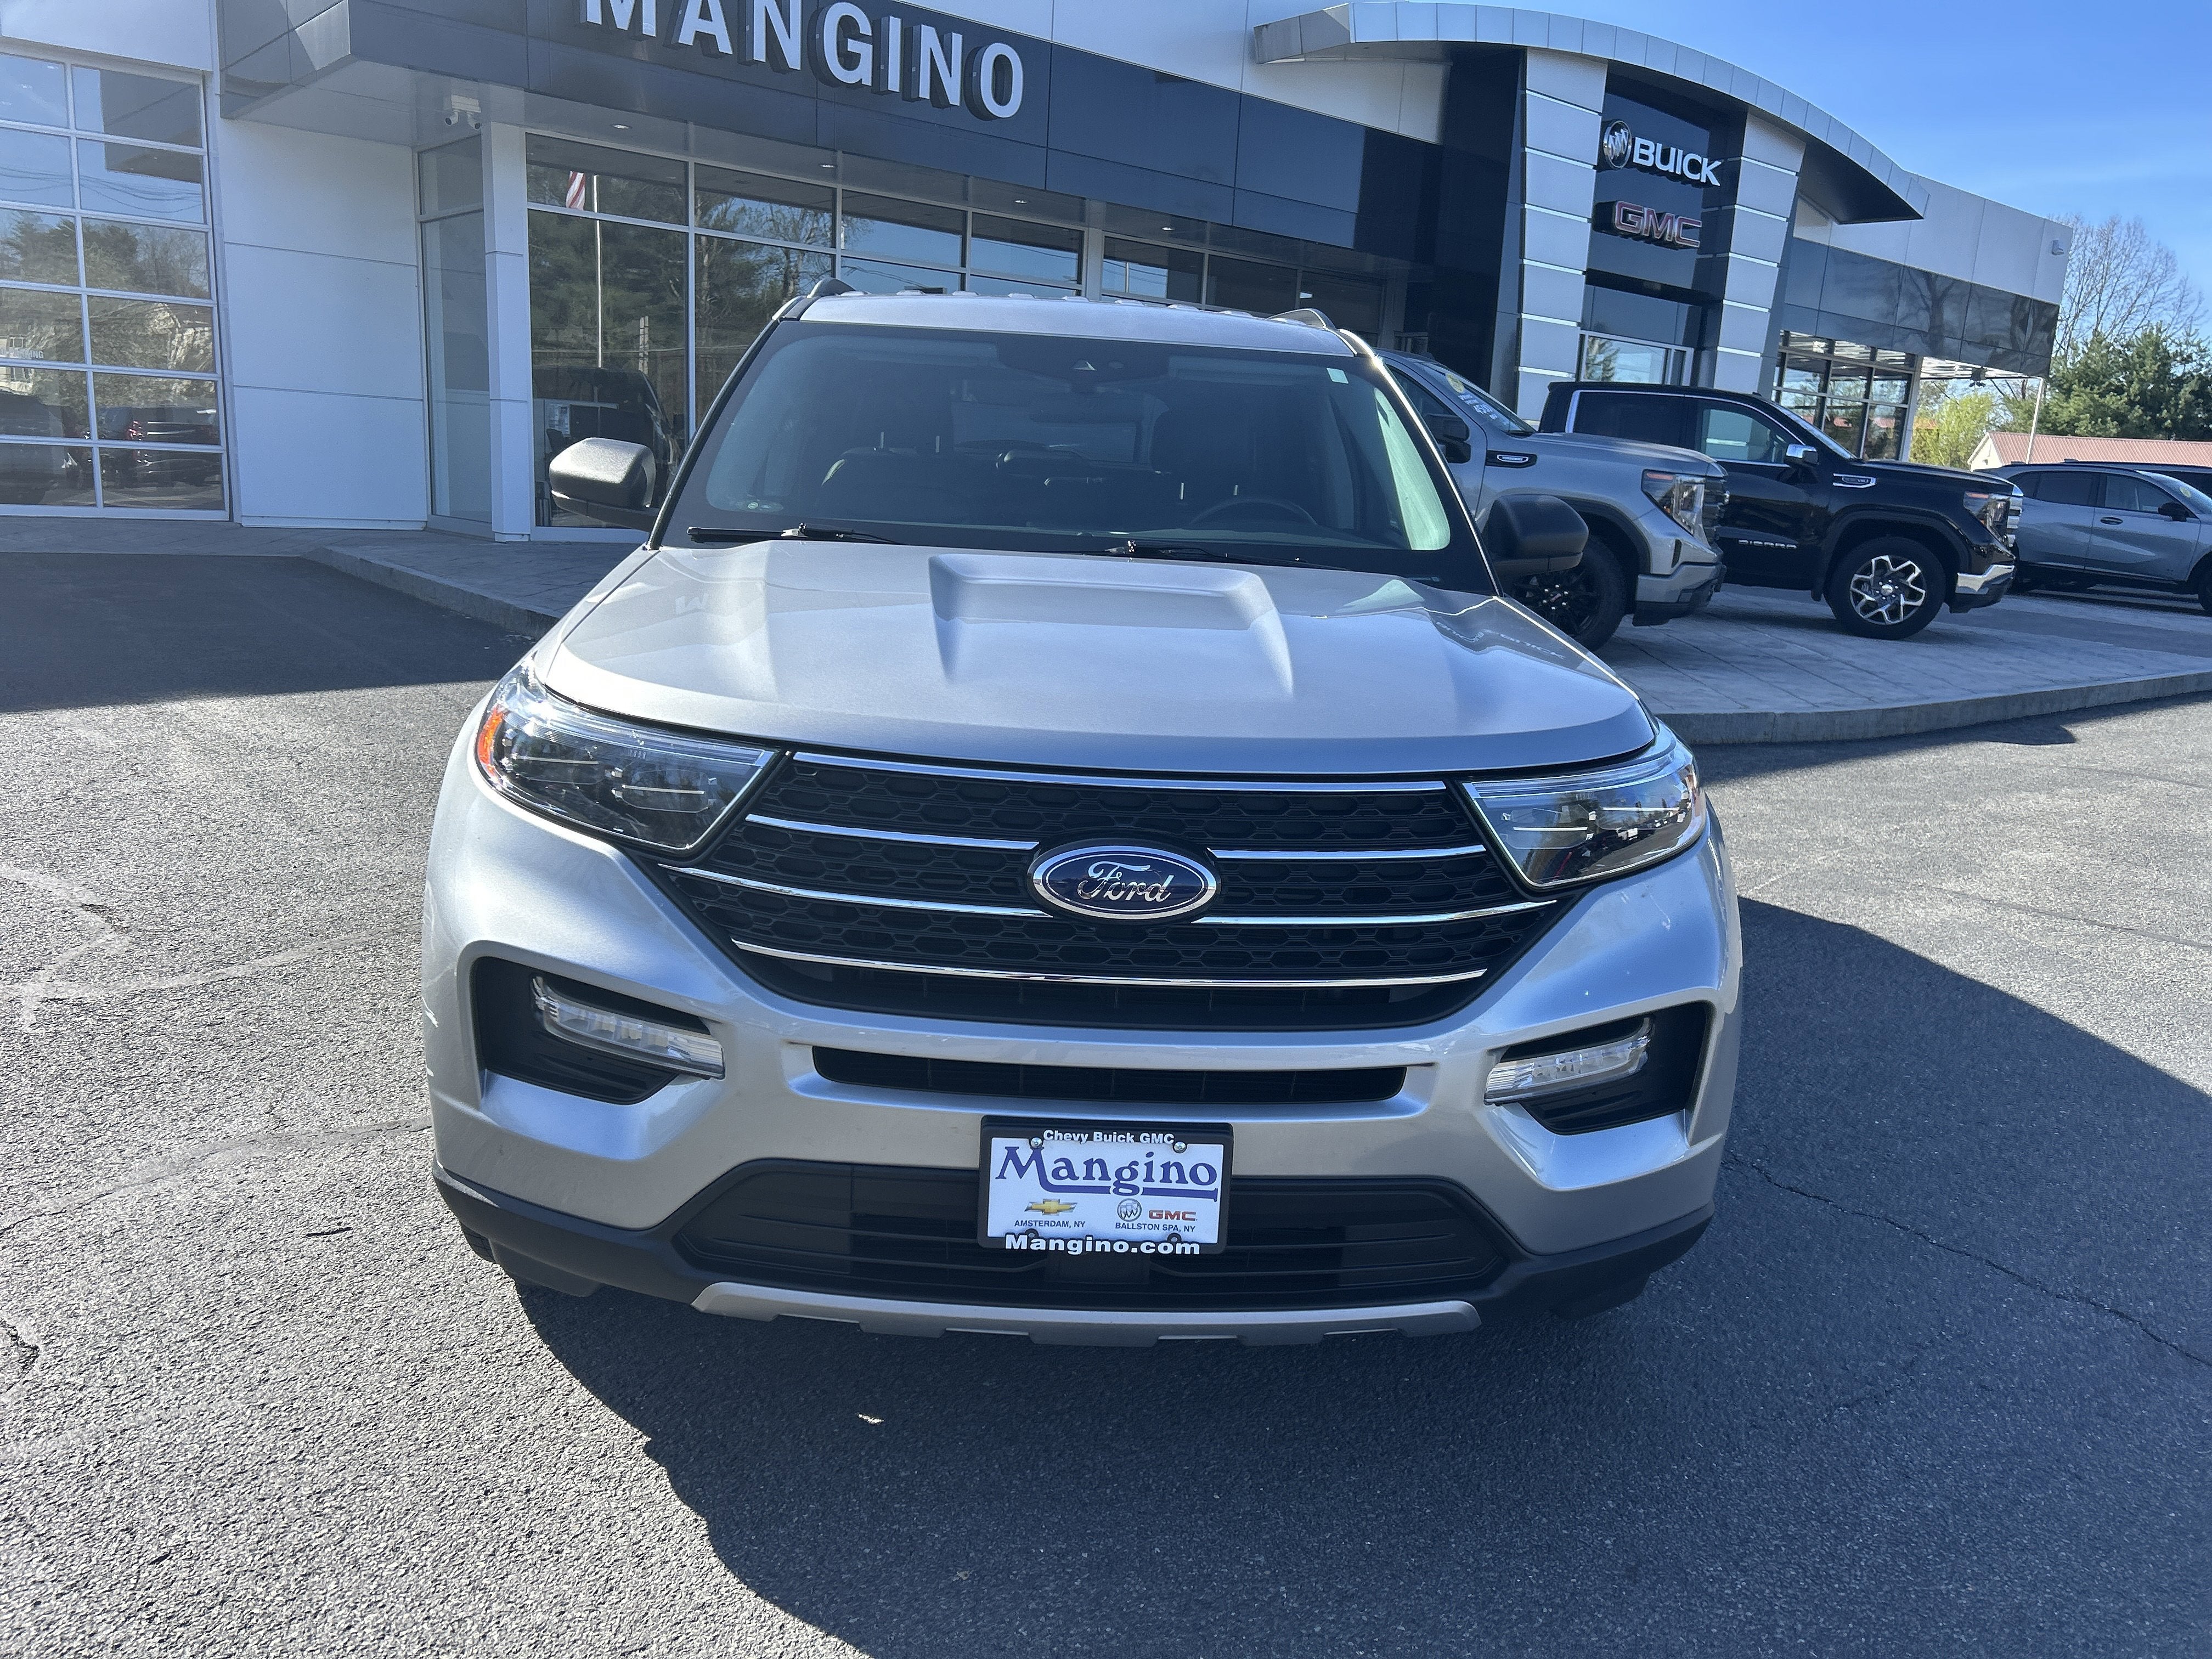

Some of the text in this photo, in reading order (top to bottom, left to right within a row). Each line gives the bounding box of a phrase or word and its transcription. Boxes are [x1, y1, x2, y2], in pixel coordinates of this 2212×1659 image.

[1632, 137, 1722, 187] BUICK
[1615, 201, 1702, 248] GMC
[1077, 861, 1174, 902] Ford
[1043, 1129, 1175, 1144] Chevy Buick GMC
[995, 1146, 1217, 1197] Mangino
[1014, 1220, 1071, 1229] AMSTERDAM,
[1149, 1209, 1197, 1221] GMC
[1115, 1222, 1160, 1231] BALLSTON
[1162, 1224, 1181, 1233] SPA,
[1005, 1234, 1200, 1255] Mangino.com
